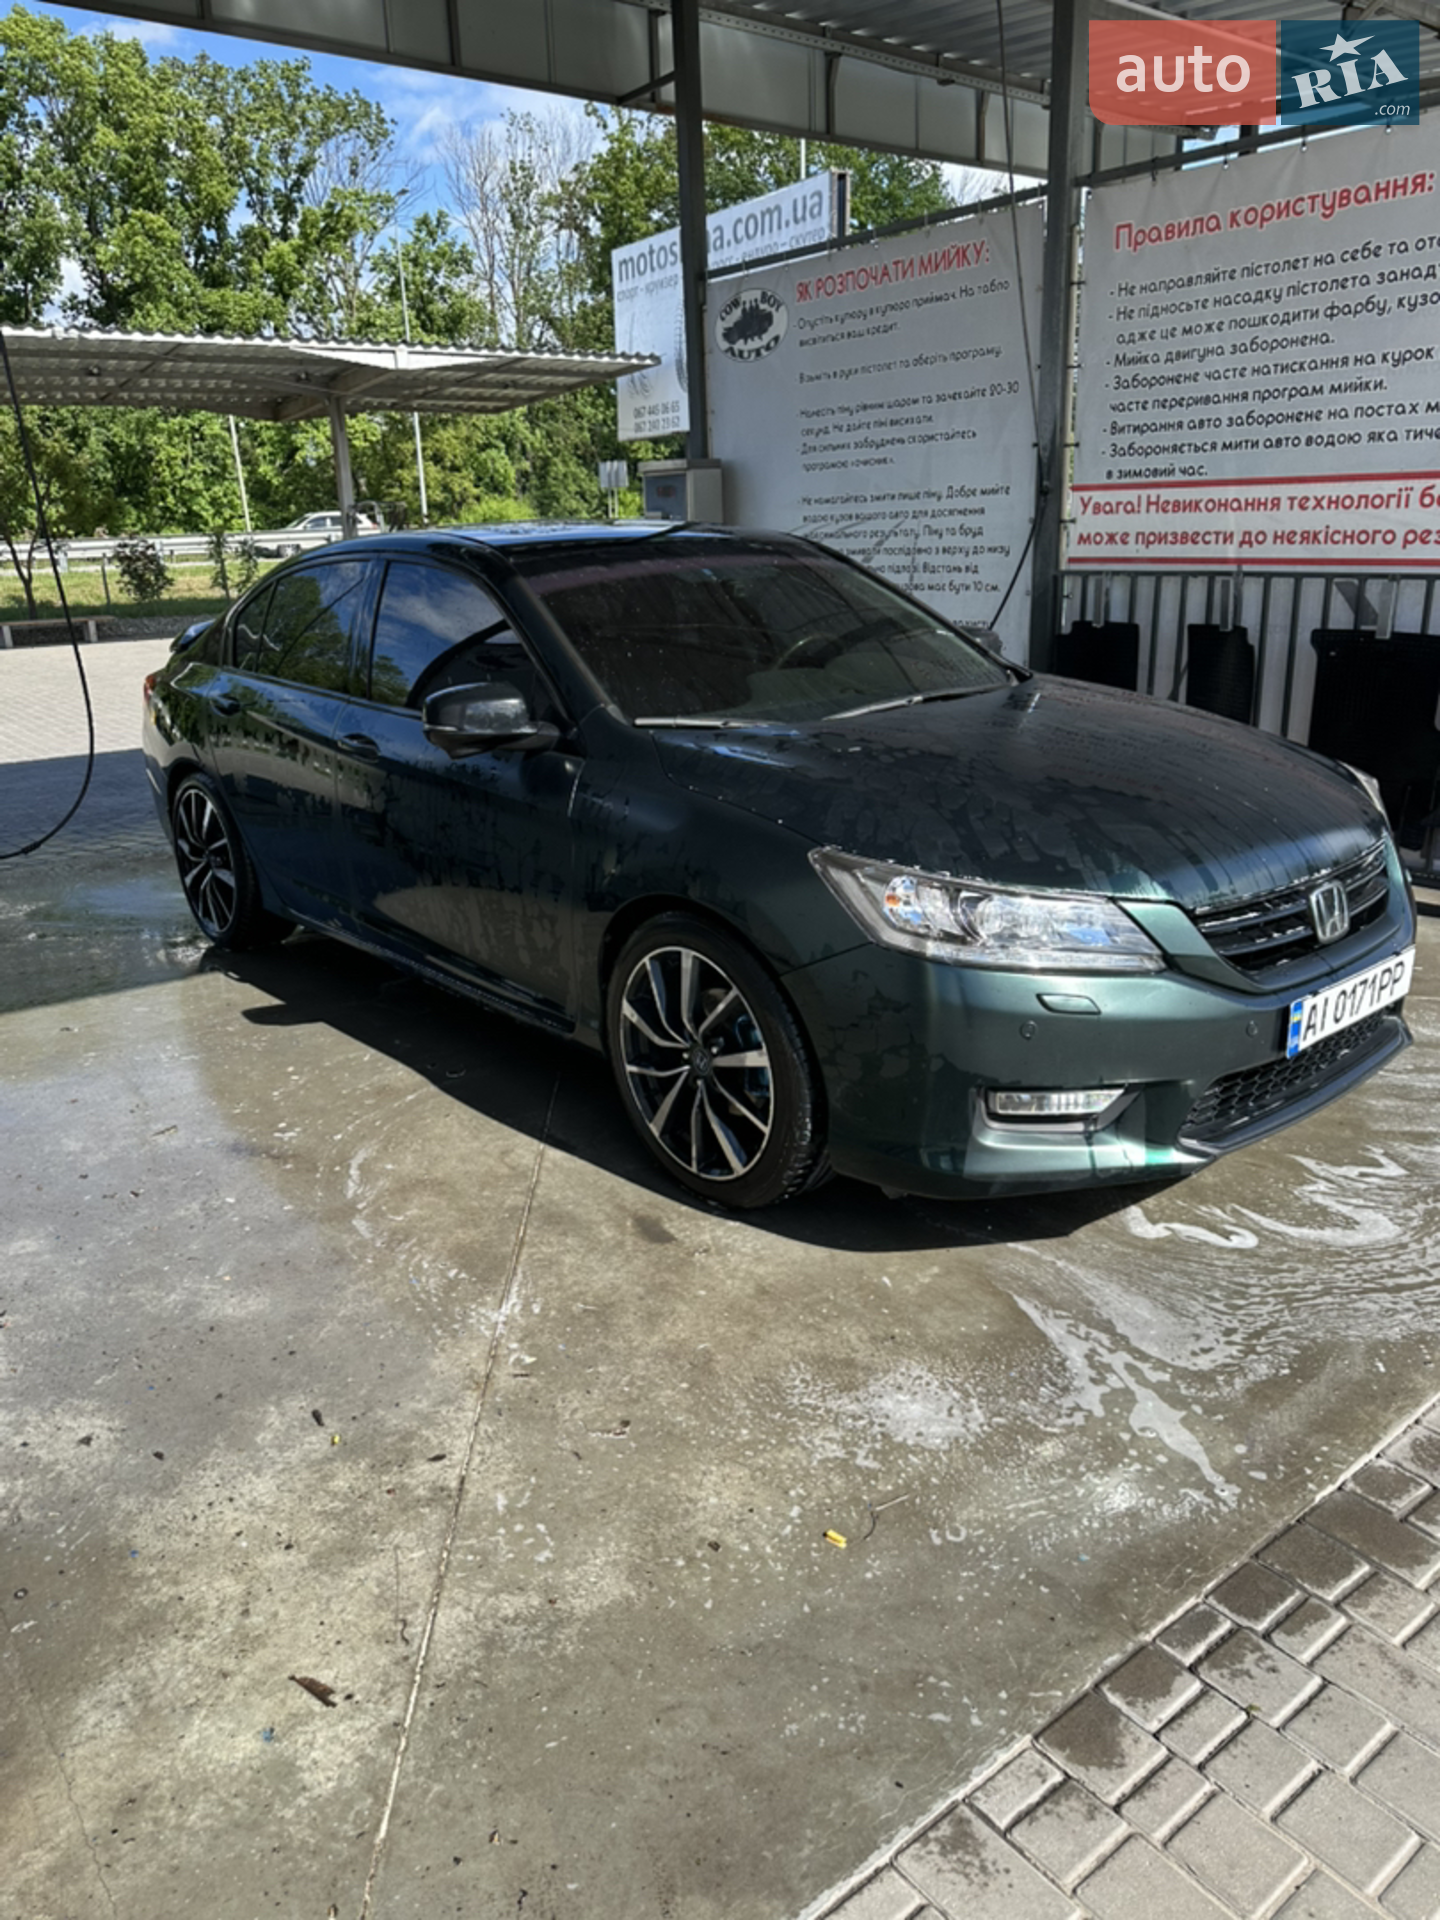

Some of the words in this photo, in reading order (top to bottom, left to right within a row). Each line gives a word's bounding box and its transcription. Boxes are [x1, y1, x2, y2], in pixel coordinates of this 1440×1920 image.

[1115, 212, 1222, 252] Правила
[1229, 171, 1435, 232] користування:
[796, 279, 812, 303] ЯК
[814, 255, 914, 300] РОЗПОЧАТИ
[917, 239, 990, 277] МИЙКУ:
[1117, 281, 1137, 297] Не
[1139, 266, 1237, 294] направляйте
[1241, 256, 1309, 279] пістолет
[1313, 252, 1336, 267] на
[1340, 240, 1383, 263] себе
[1387, 240, 1409, 255] та
[960, 284, 975, 299] На
[977, 278, 1010, 294] табло
[1116, 305, 1135, 321] Не
[1137, 298, 1209, 319] підносьте
[1213, 285, 1283, 308] насадку
[1286, 274, 1370, 298] пістолета
[720, 297, 740, 321] COW
[760, 290, 784, 313] BOY
[1116, 328, 1156, 346] адже
[1160, 325, 1178, 341] це
[1181, 320, 1225, 337] може
[1228, 306, 1320, 331] пошкодити
[1323, 294, 1393, 322] фарбу,
[724, 334, 780, 360] AUTO
[1113, 350, 1160, 369] Мийка
[1164, 344, 1226, 364] двигуна
[1230, 331, 1335, 356] заборонена.
[899, 359, 910, 369] та
[1112, 370, 1200, 391] Заборонене
[1204, 365, 1248, 382] часте
[1251, 354, 1349, 379] натискання
[1353, 352, 1376, 368] на
[1381, 346, 1435, 368] курок
[922, 394, 934, 404] та
[935, 385, 987, 403] зачекайте
[989, 380, 1020, 398] 20-30
[1109, 398, 1149, 414] часте
[1151, 389, 1249, 411] переривання
[1252, 383, 1324, 404] програм
[1329, 376, 1388, 396] мийки.
[1110, 419, 1184, 437] Витирання
[1187, 416, 1223, 432] авто
[1226, 409, 1324, 430] заборонене
[1327, 407, 1349, 421] на
[1353, 401, 1419, 419] постах
[907, 427, 977, 445] скористайтесь
[1109, 440, 1217, 458] Забороняється
[1221, 437, 1260, 451] мити
[1263, 434, 1301, 450] авто
[1305, 431, 1362, 448] водою
[1367, 429, 1398, 444] яка
[1105, 468, 1113, 480] в
[1116, 463, 1177, 480] зимовий
[1179, 464, 1208, 478] час.
[946, 485, 977, 500] Добре
[980, 483, 1010, 497] мийте
[1079, 493, 1142, 516] Увага!
[1146, 492, 1281, 516] Невиконання
[1286, 486, 1414, 512] технології
[911, 508, 929, 520] для
[930, 506, 986, 519] досягнення
[923, 523, 943, 540] Піну
[946, 527, 957, 537] та
[958, 522, 984, 540] бруд
[1077, 531, 1130, 546] може
[1134, 529, 1234, 550] призвести
[1238, 529, 1268, 549] до
[1272, 524, 1397, 546] неякісного
[942, 545, 970, 558] верху
[972, 545, 986, 557] до
[987, 544, 1011, 558] низу
[922, 560, 963, 575] Відстань
[964, 561, 979, 575] від
[927, 582, 947, 592] має
[949, 579, 971, 595] бути
[972, 580, 983, 592] 10
